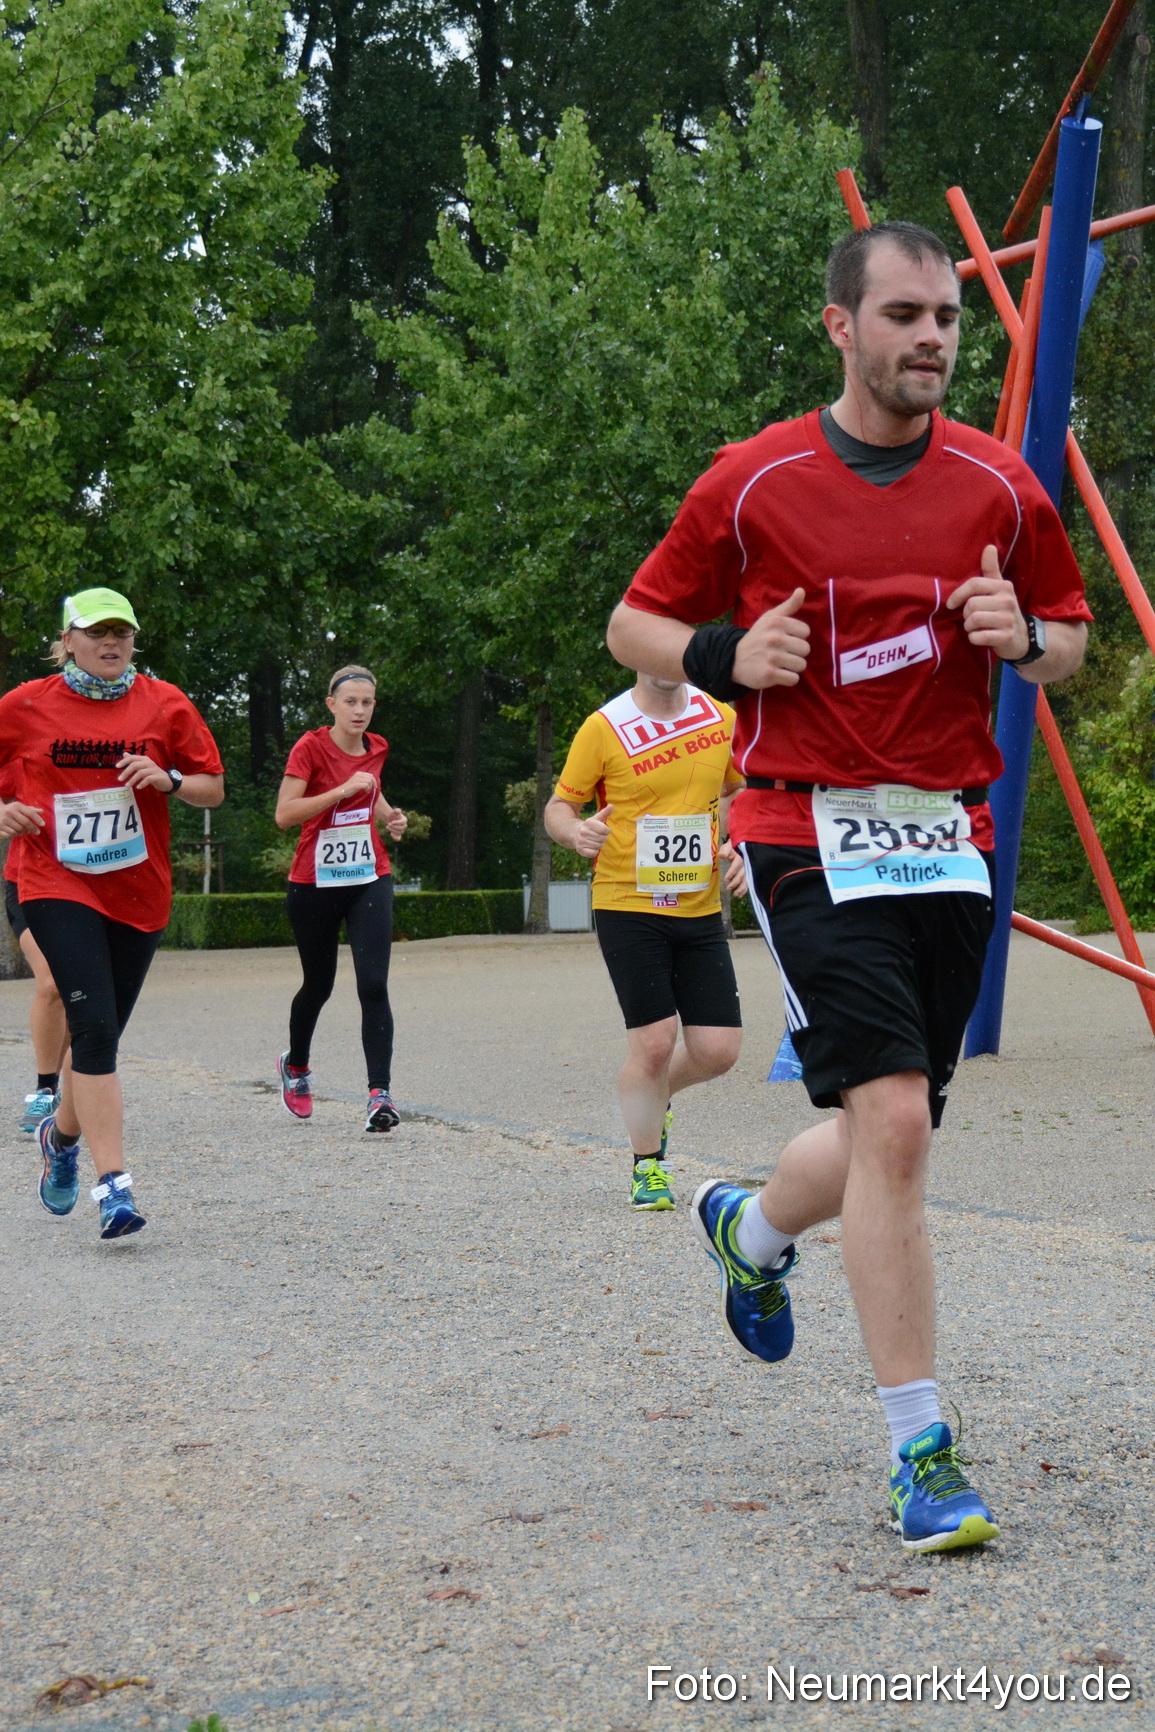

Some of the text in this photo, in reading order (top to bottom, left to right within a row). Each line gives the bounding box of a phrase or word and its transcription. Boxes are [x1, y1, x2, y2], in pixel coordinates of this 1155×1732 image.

[867, 644, 907, 670] DEHN
[56, 753, 78, 765] RUN
[632, 729, 731, 776] MAX BÖGL
[826, 797, 877, 810] NeuerMarkt
[887, 790, 952, 811] BOCK
[66, 805, 138, 845] 2774
[674, 817, 706, 828] BOCK
[86, 847, 128, 864] Andrea
[322, 840, 371, 865] 2374
[654, 834, 701, 863] 326
[829, 852, 836, 860] B
[331, 868, 365, 878] Veronika
[658, 871, 698, 882] Scherer
[875, 862, 948, 883] Patrick
